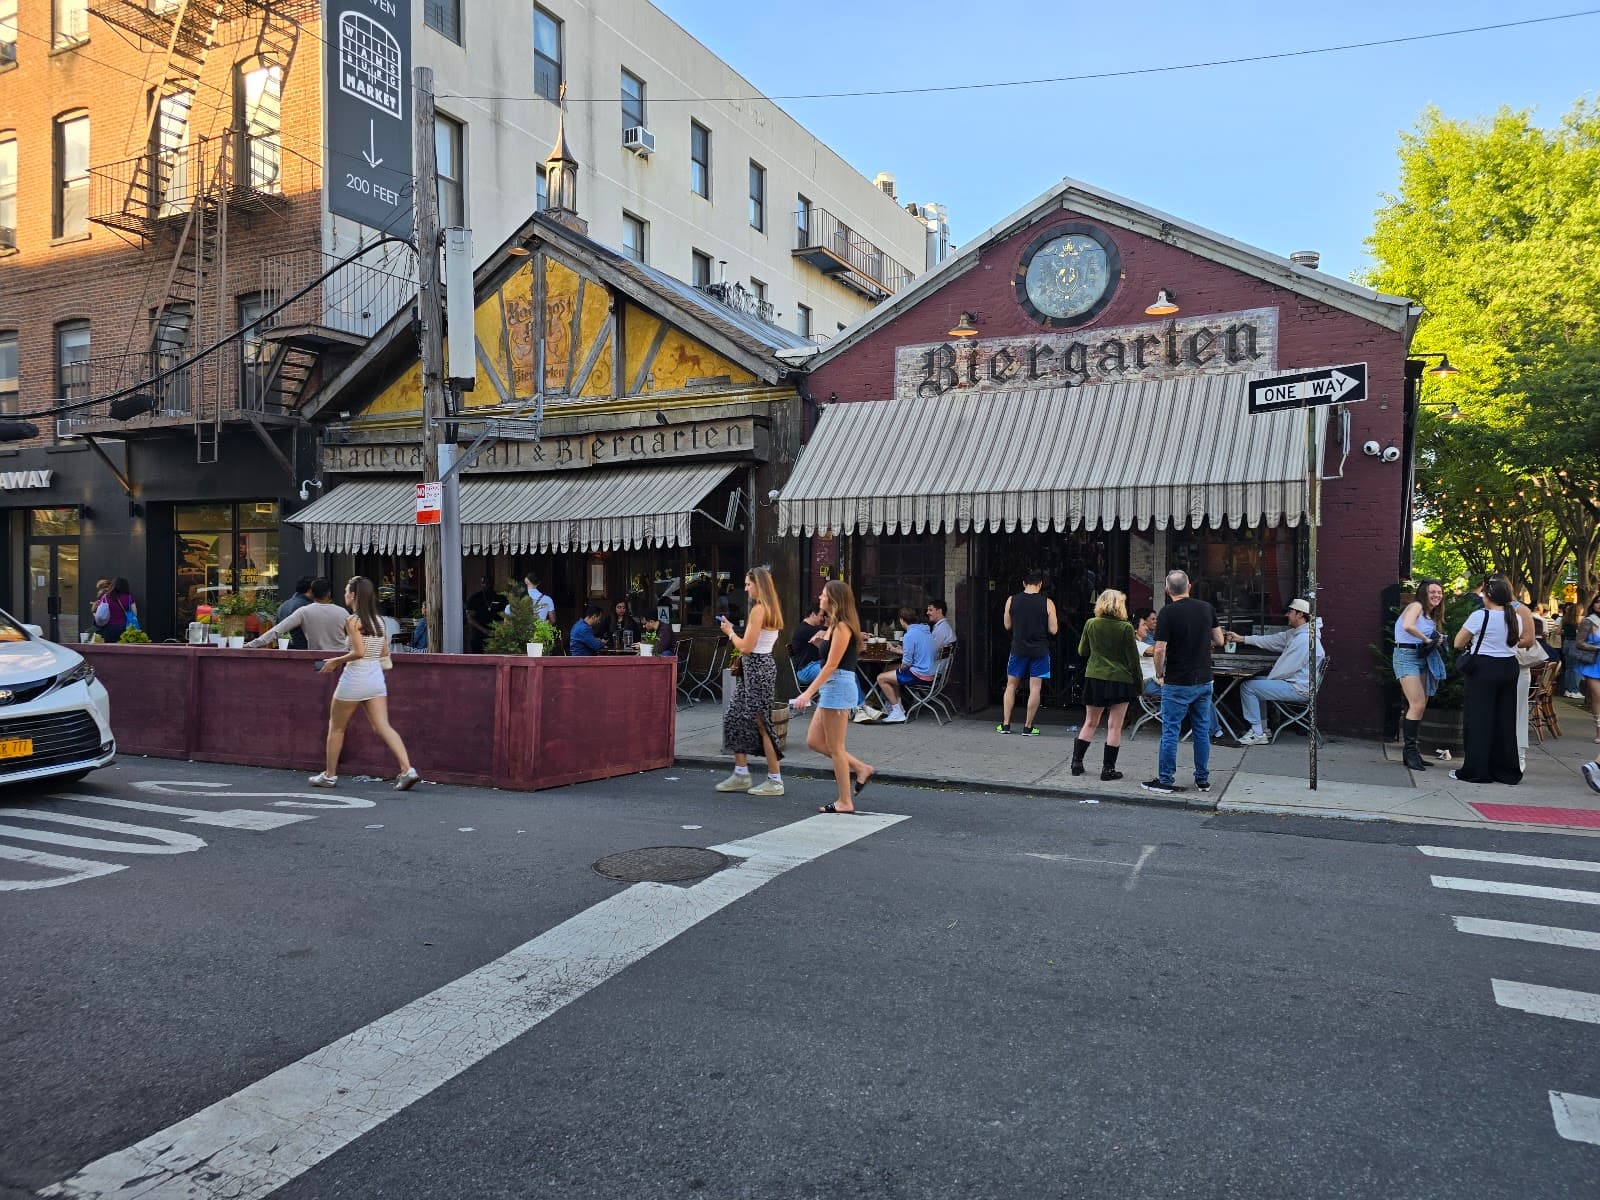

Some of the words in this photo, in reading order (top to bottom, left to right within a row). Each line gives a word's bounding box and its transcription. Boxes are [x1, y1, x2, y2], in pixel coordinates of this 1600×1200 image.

[346, 72, 396, 109] MARKET
[346, 173, 370, 194] 200
[373, 183, 400, 206] FEET
[916, 319, 1264, 399] Biergarten
[1264, 385, 1297, 402] ONE
[1312, 377, 1347, 396] WAY
[324, 445, 424, 471] Radega
[533, 443, 546, 462] &
[555, 423, 743, 465] Biergarten
[659, 609, 668, 618] A
